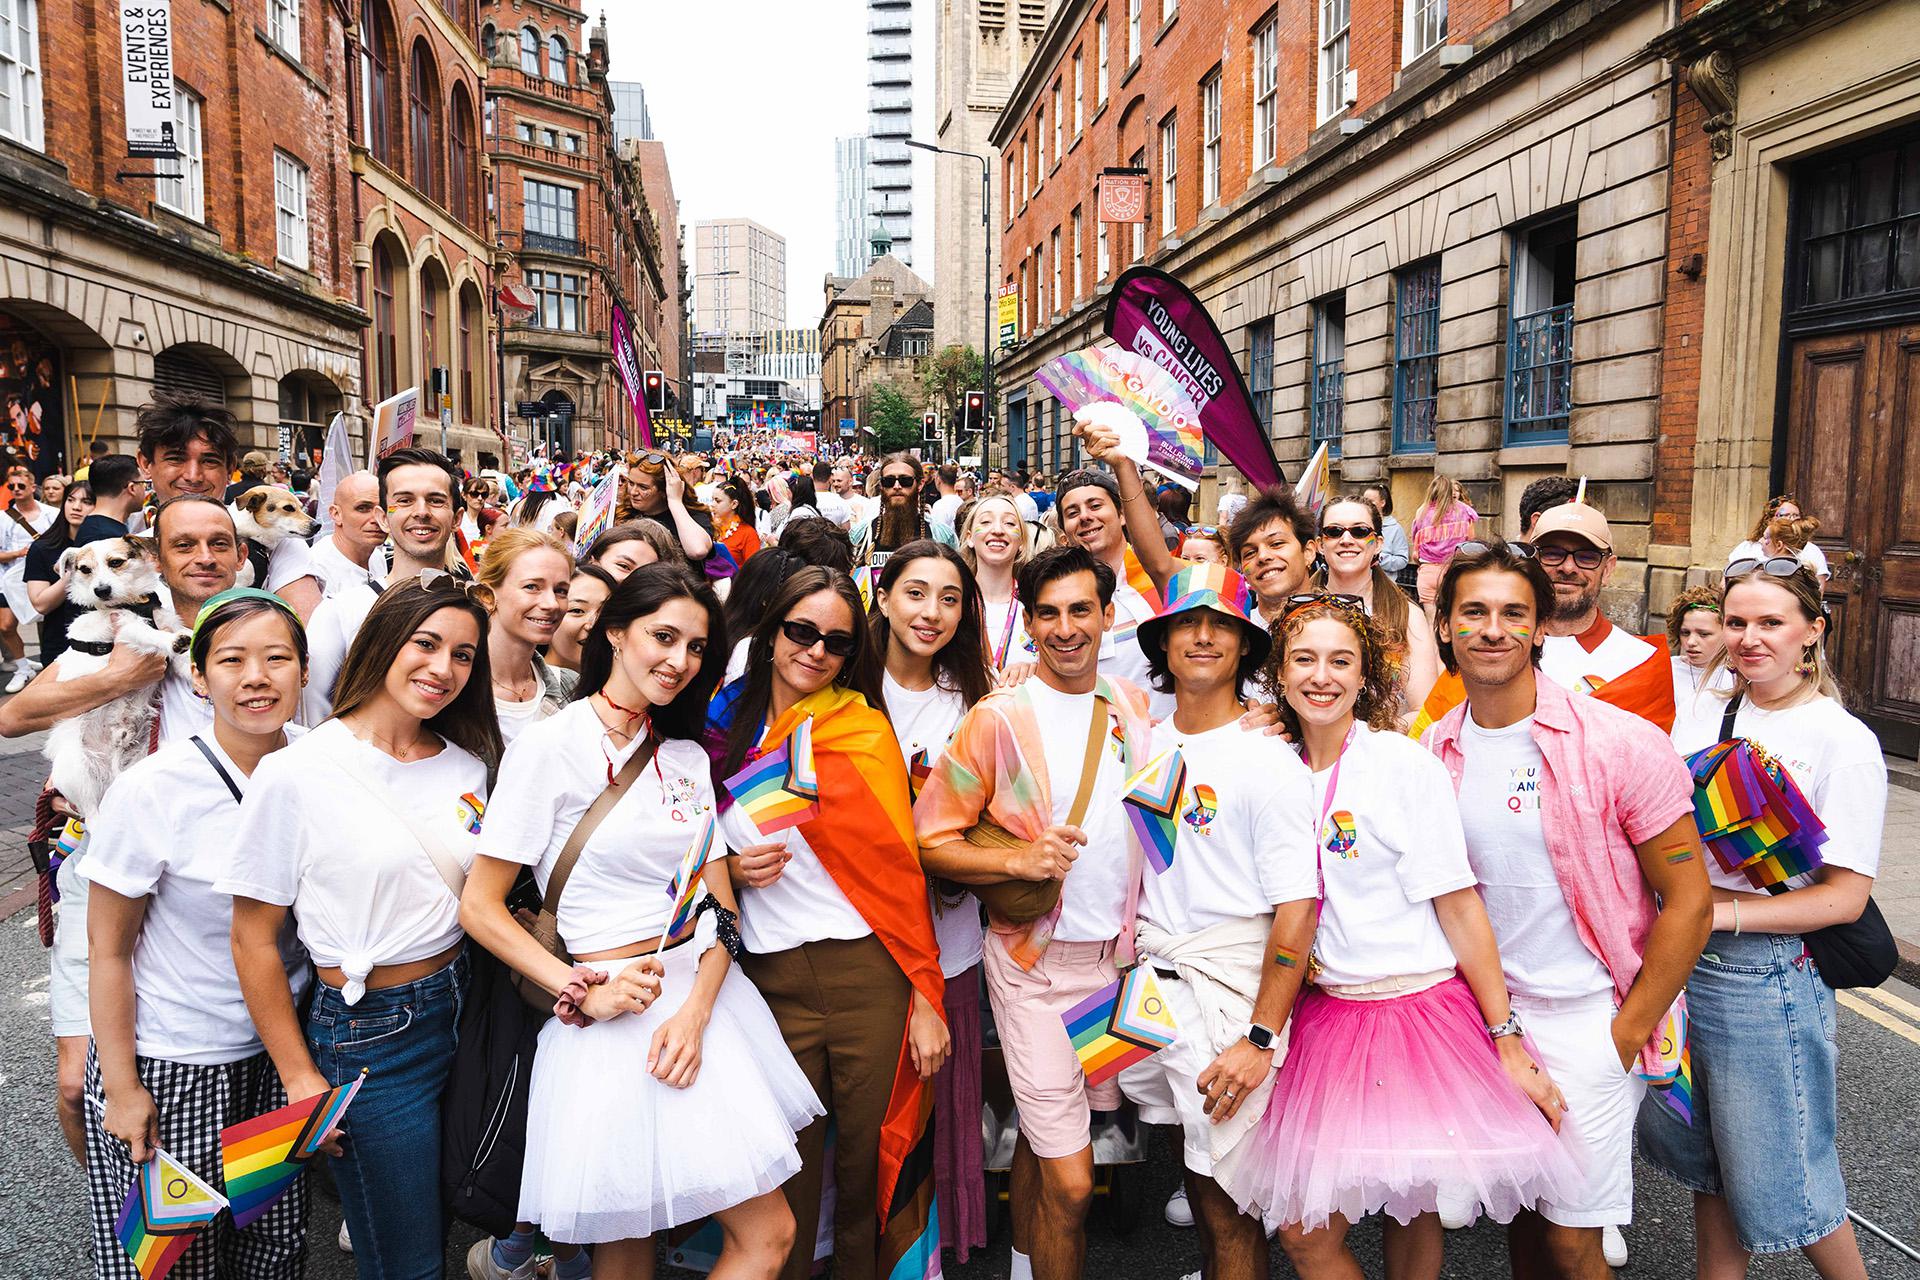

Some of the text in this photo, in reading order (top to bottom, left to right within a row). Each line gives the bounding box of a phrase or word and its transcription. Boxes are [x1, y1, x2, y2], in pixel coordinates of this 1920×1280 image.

[124, 7, 147, 83] EVENTS &
[147, 8, 171, 109] EXPERIENCES
[998, 283, 1017, 297] TO LET
[1147, 297, 1223, 396] YOUNG LIVES
[1126, 375, 1188, 429] GAYDIO
[1154, 349, 1206, 410] CANCER
[1160, 440, 1195, 466] BULLRING
[1508, 781, 1542, 793] DANC
[1509, 767, 1536, 778] YOU
